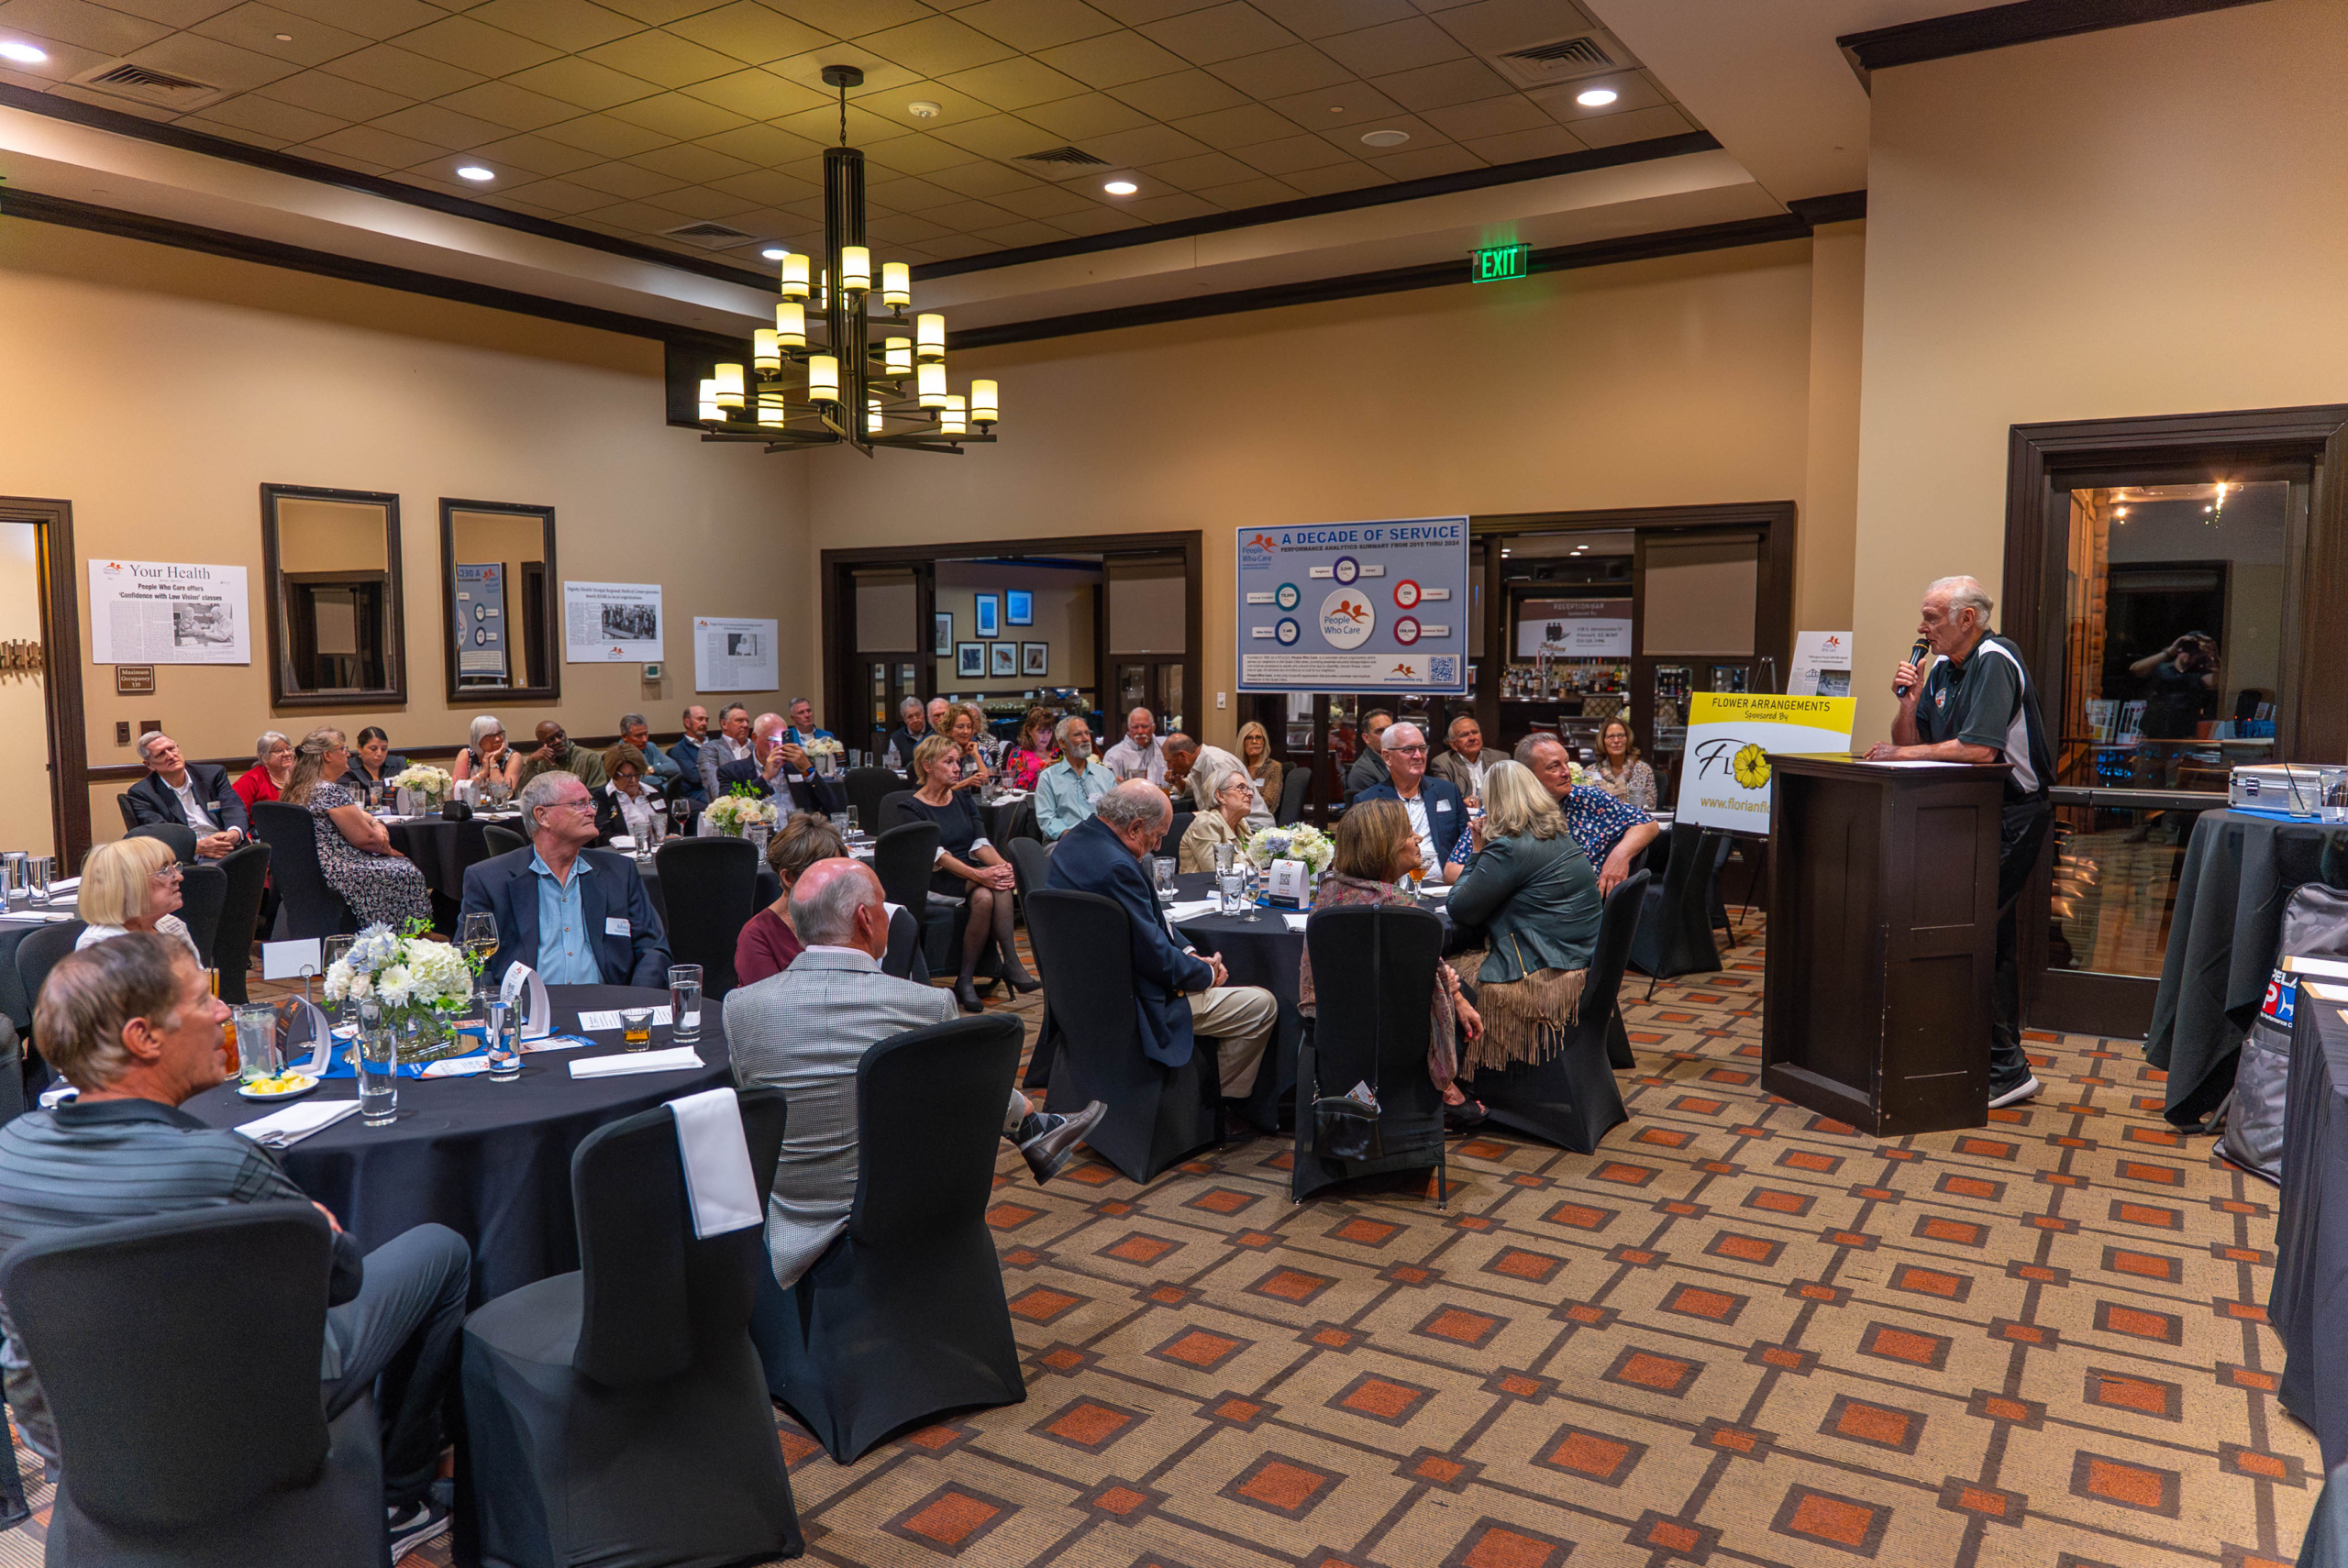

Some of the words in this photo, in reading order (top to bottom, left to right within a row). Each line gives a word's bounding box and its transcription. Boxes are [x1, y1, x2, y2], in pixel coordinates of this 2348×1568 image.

[1482, 248, 1518, 279] EXIT
[1281, 534, 1291, 545] A
[1297, 530, 1358, 545] DECADE
[1363, 529, 1384, 542] OF
[1390, 525, 1460, 540] SERVICE
[129, 564, 163, 578] Your
[167, 566, 211, 580] Health
[1324, 615, 1351, 625] People
[1324, 626, 1342, 635] Who
[1344, 625, 1361, 635] Care
[1711, 698, 1749, 708] FLOWER
[1750, 699, 1831, 712] ARRANGEMENTS
[1744, 710, 1777, 720] Sponsored
[1778, 712, 1789, 722] By
[1700, 797, 1771, 814] www.florianflo
